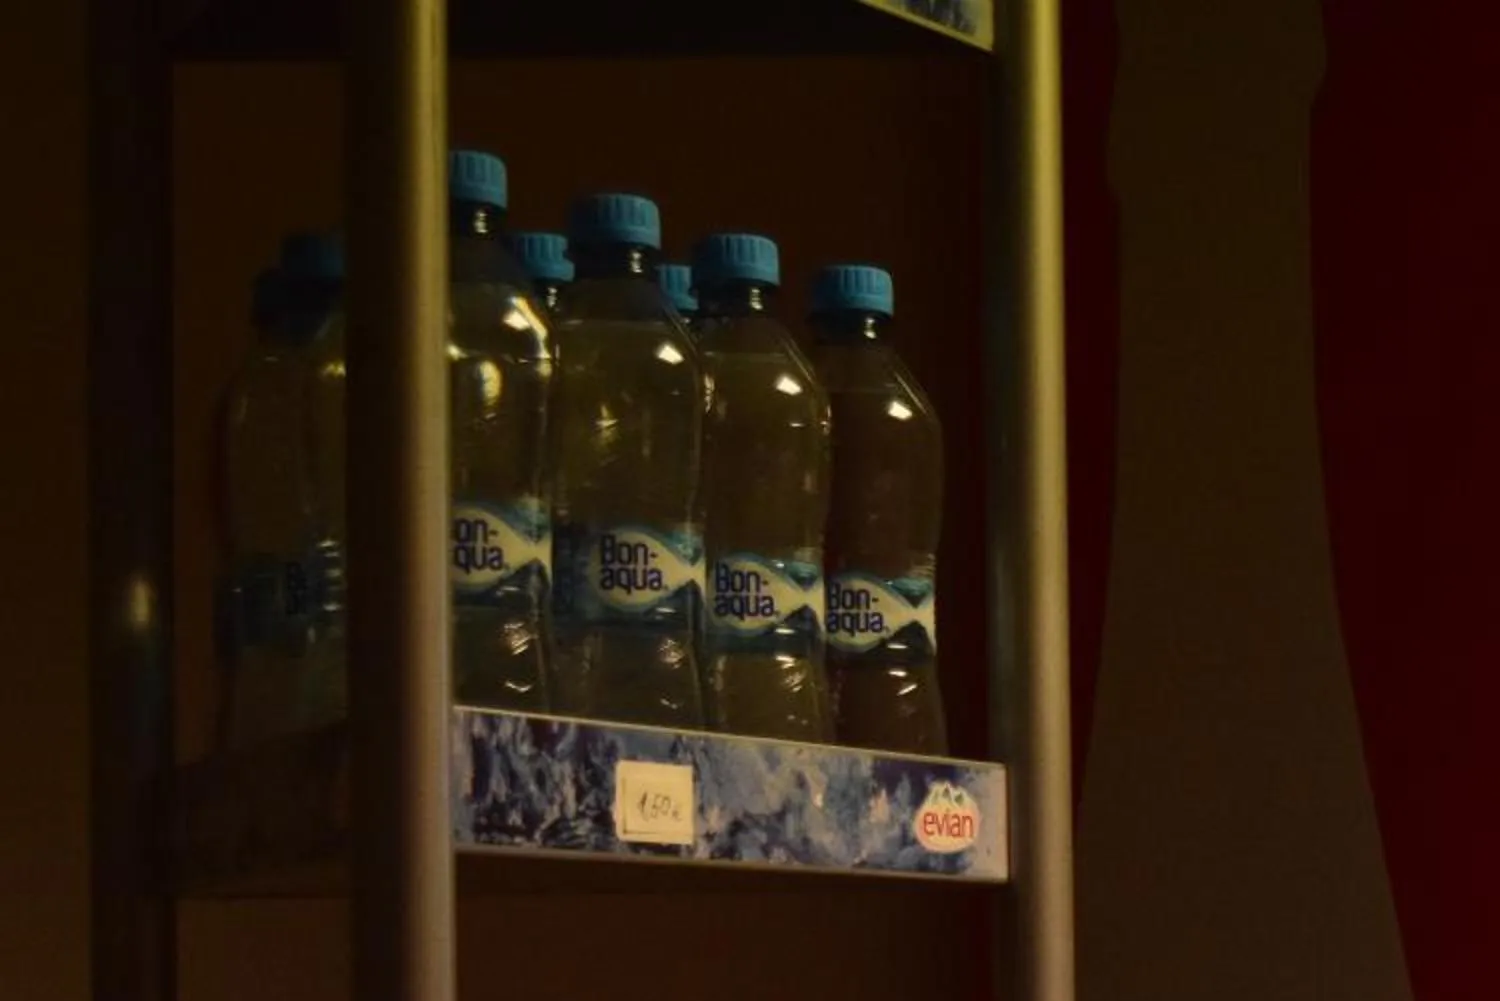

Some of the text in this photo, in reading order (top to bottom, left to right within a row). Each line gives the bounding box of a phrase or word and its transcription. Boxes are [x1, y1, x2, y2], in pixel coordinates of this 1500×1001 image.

[600, 534, 659, 567] Bon-
[715, 562, 769, 593] Bon-
[827, 582, 879, 610] Bon-
[922, 809, 975, 840] evian
